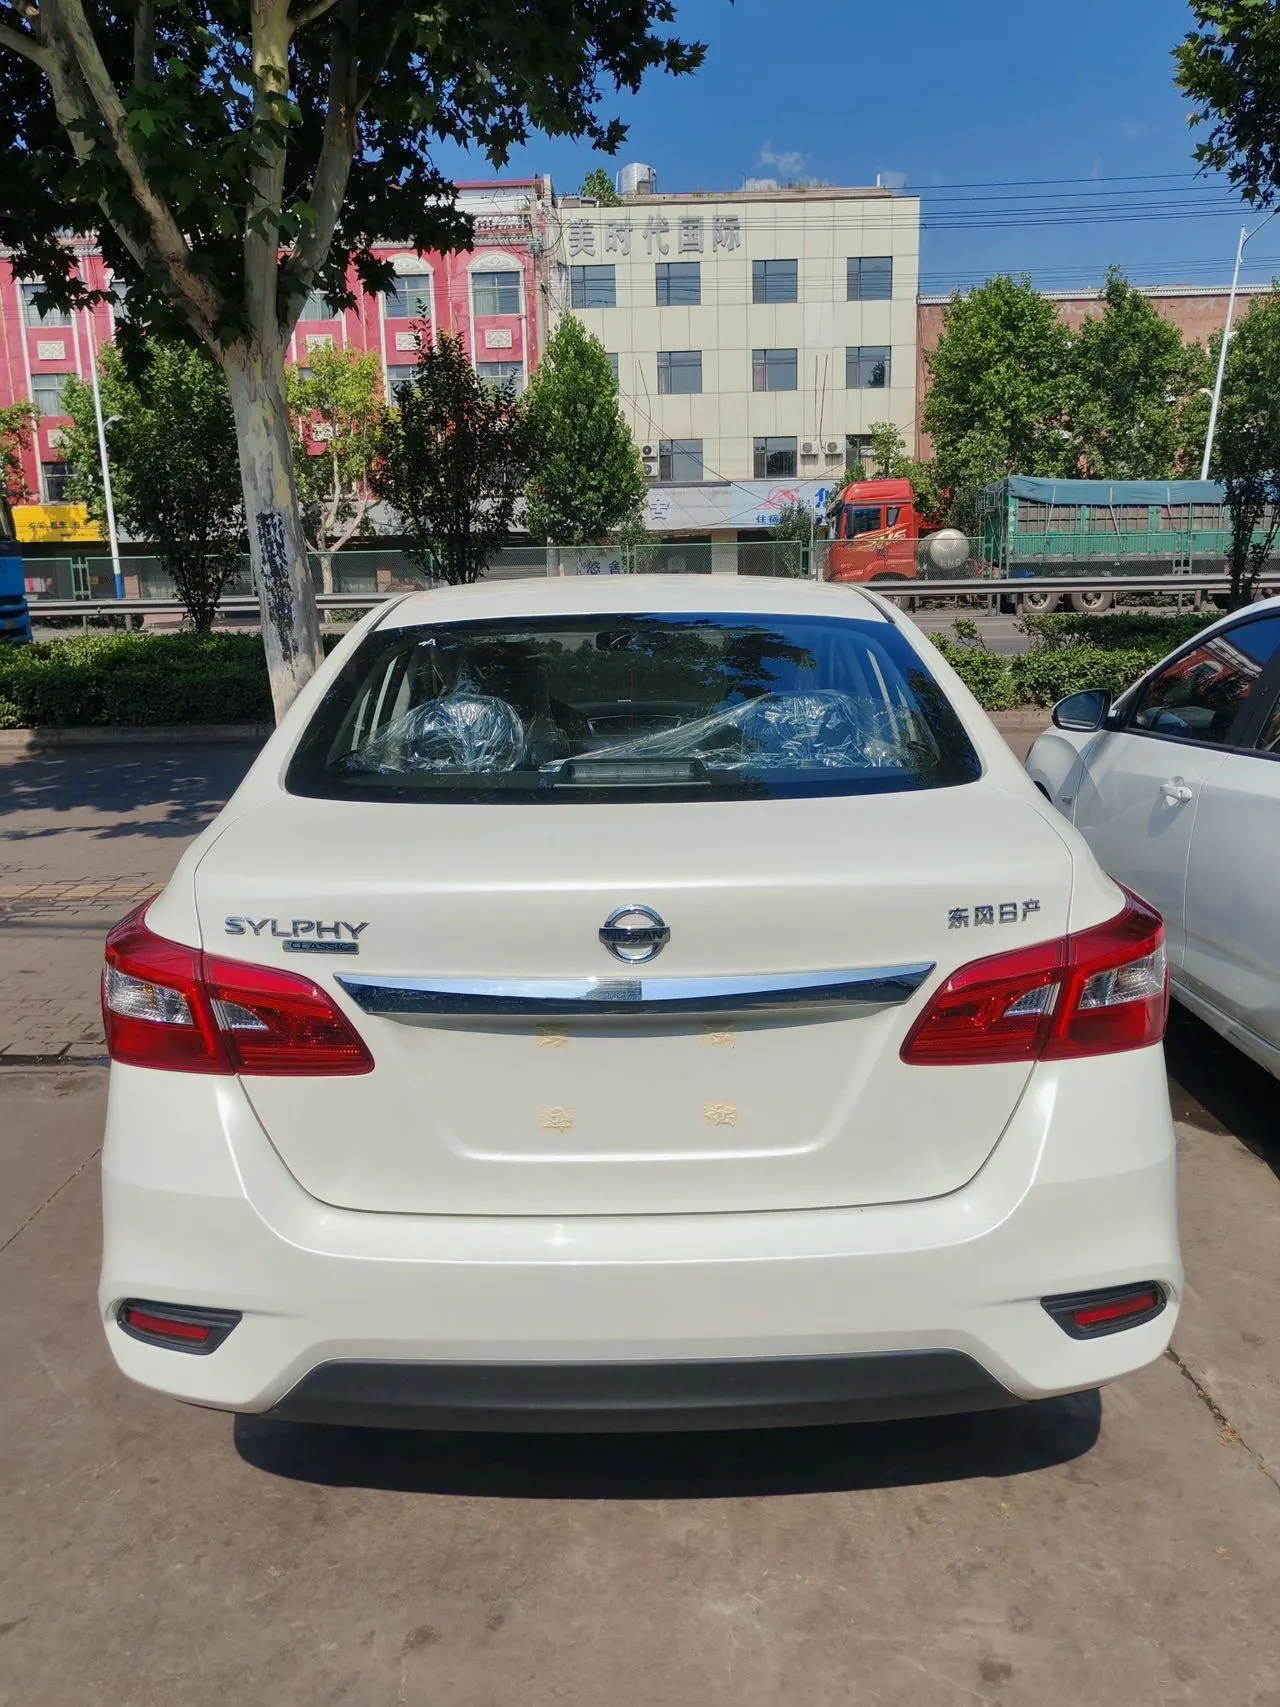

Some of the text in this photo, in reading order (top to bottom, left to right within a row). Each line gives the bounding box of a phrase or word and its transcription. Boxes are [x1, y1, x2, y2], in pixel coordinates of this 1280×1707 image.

[568, 211, 742, 257] 美时代国际
[224, 915, 370, 940] SYLPHY
[947, 898, 1041, 929] 东风日产
[290, 941, 347, 951] CLASSIC
